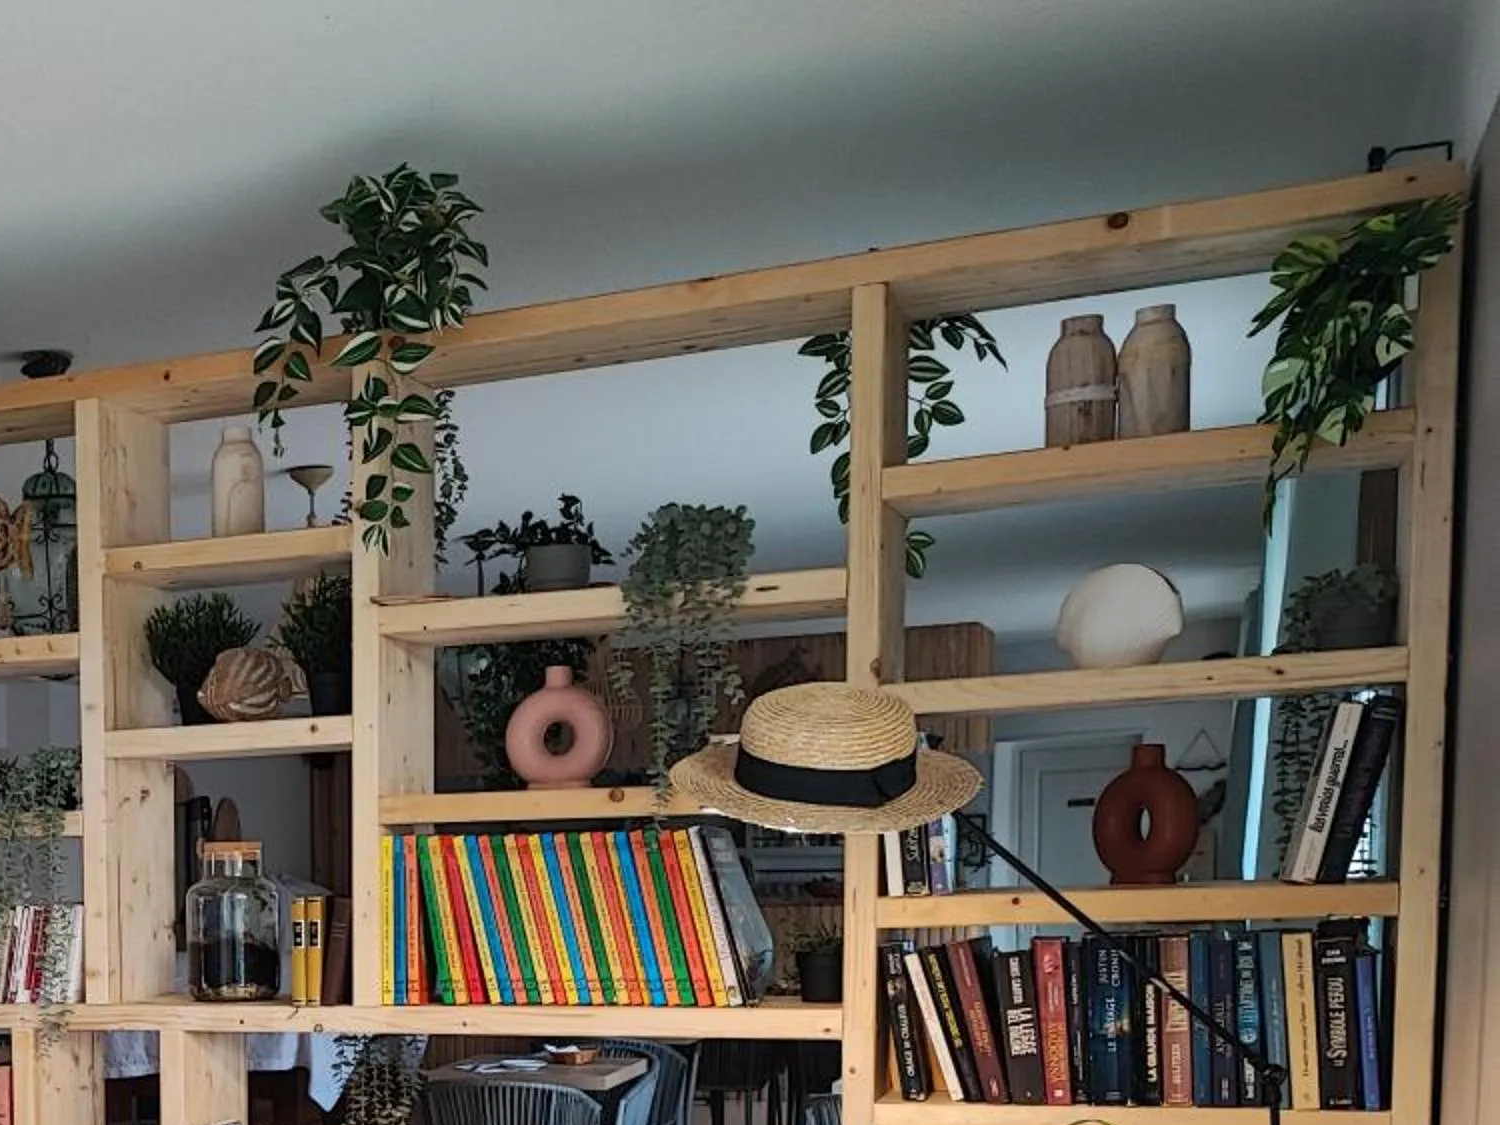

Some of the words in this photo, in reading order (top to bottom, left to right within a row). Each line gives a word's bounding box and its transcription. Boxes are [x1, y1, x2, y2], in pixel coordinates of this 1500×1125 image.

[1098, 949, 1108, 983] JUSTIN
[1145, 983, 1155, 1024] MAISON
[1326, 976, 1344, 1008] PERDU
[1017, 1006, 1033, 1021] LA
[1107, 1041, 1116, 1051] LE
[1146, 1026, 1157, 1066] GRANDE
[1325, 1010, 1347, 1057] SYMBOLE
[1147, 1067, 1157, 1081] LA
